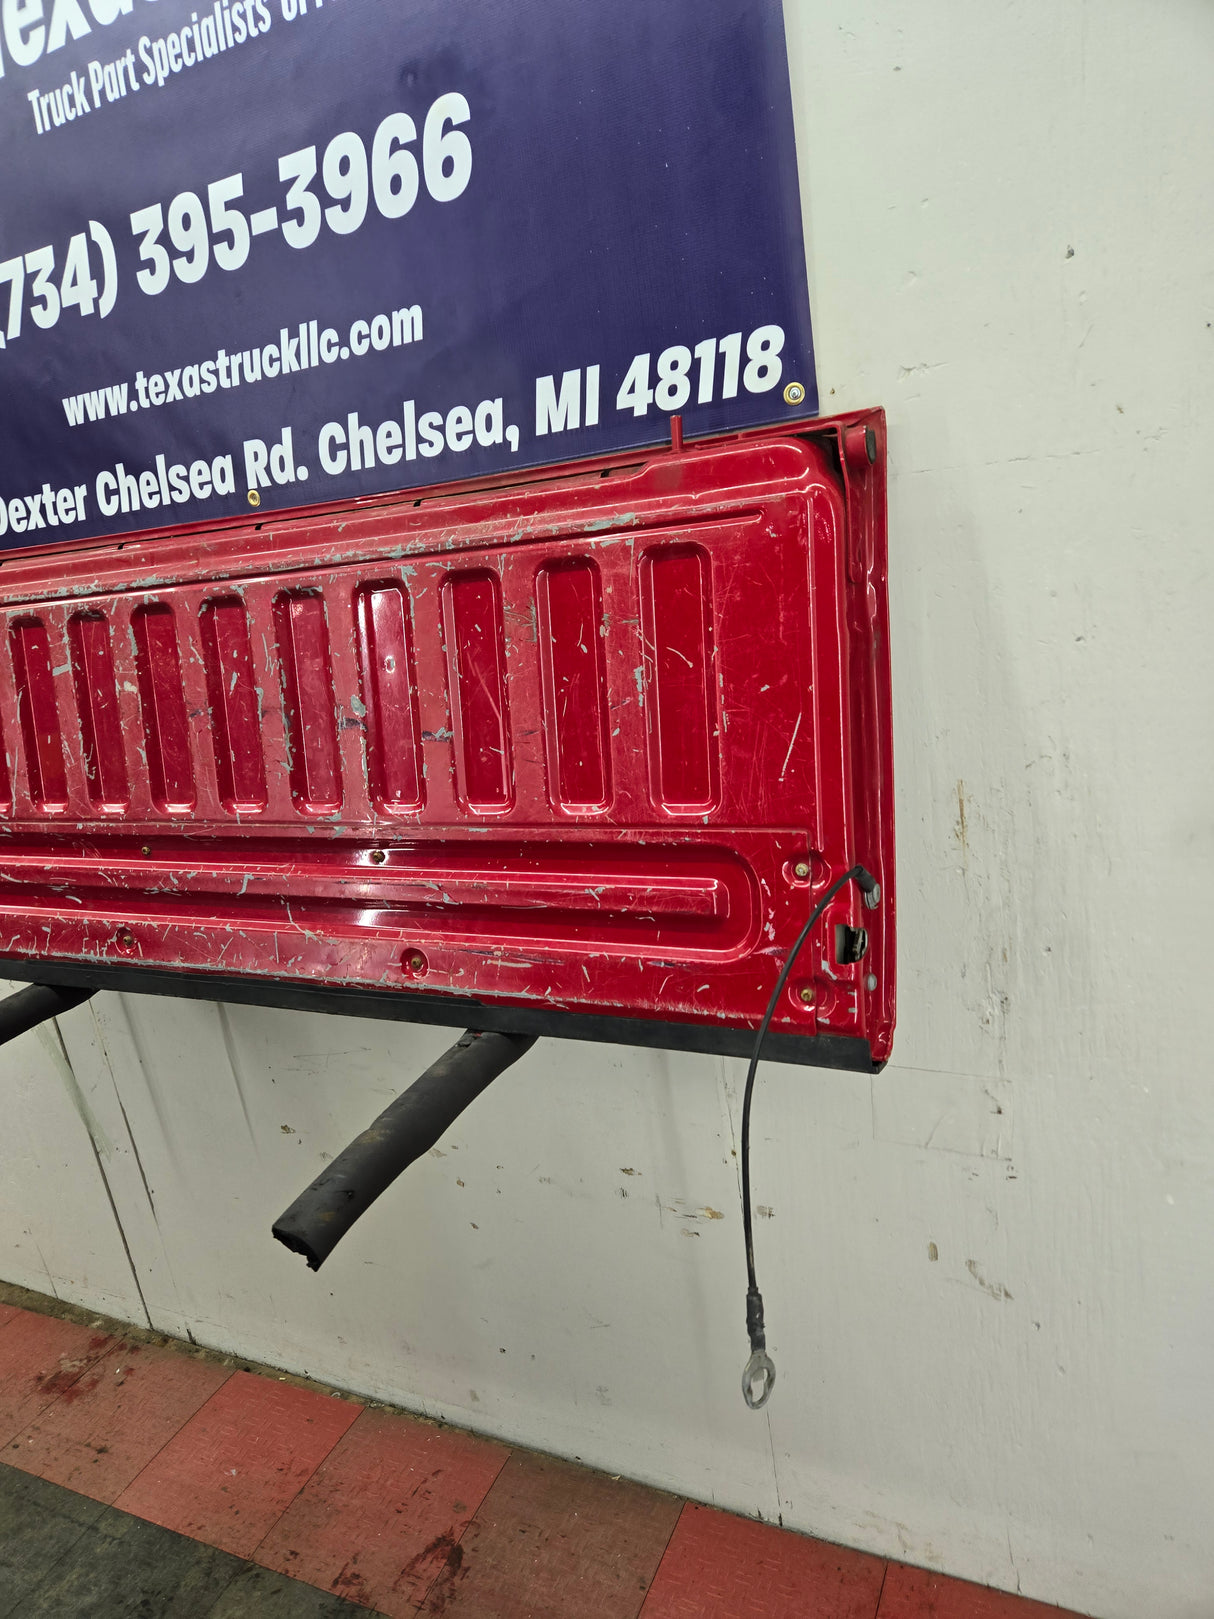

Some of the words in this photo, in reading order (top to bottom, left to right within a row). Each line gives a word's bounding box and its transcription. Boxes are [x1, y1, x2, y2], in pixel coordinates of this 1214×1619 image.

[27, 70, 91, 135] Truck
[87, 48, 140, 109] Part
[138, 0, 272, 87] Specialists
[0, 220, 118, 349] 734)
[130, 92, 473, 296] 395-3966
[61, 304, 424, 428] www.texastruckllc.com
[95, 454, 236, 517] Chelsea
[243, 421, 309, 490] Rd.
[318, 399, 520, 475] Chelsea,
[535, 364, 600, 436] MI
[616, 324, 785, 417] 48118
